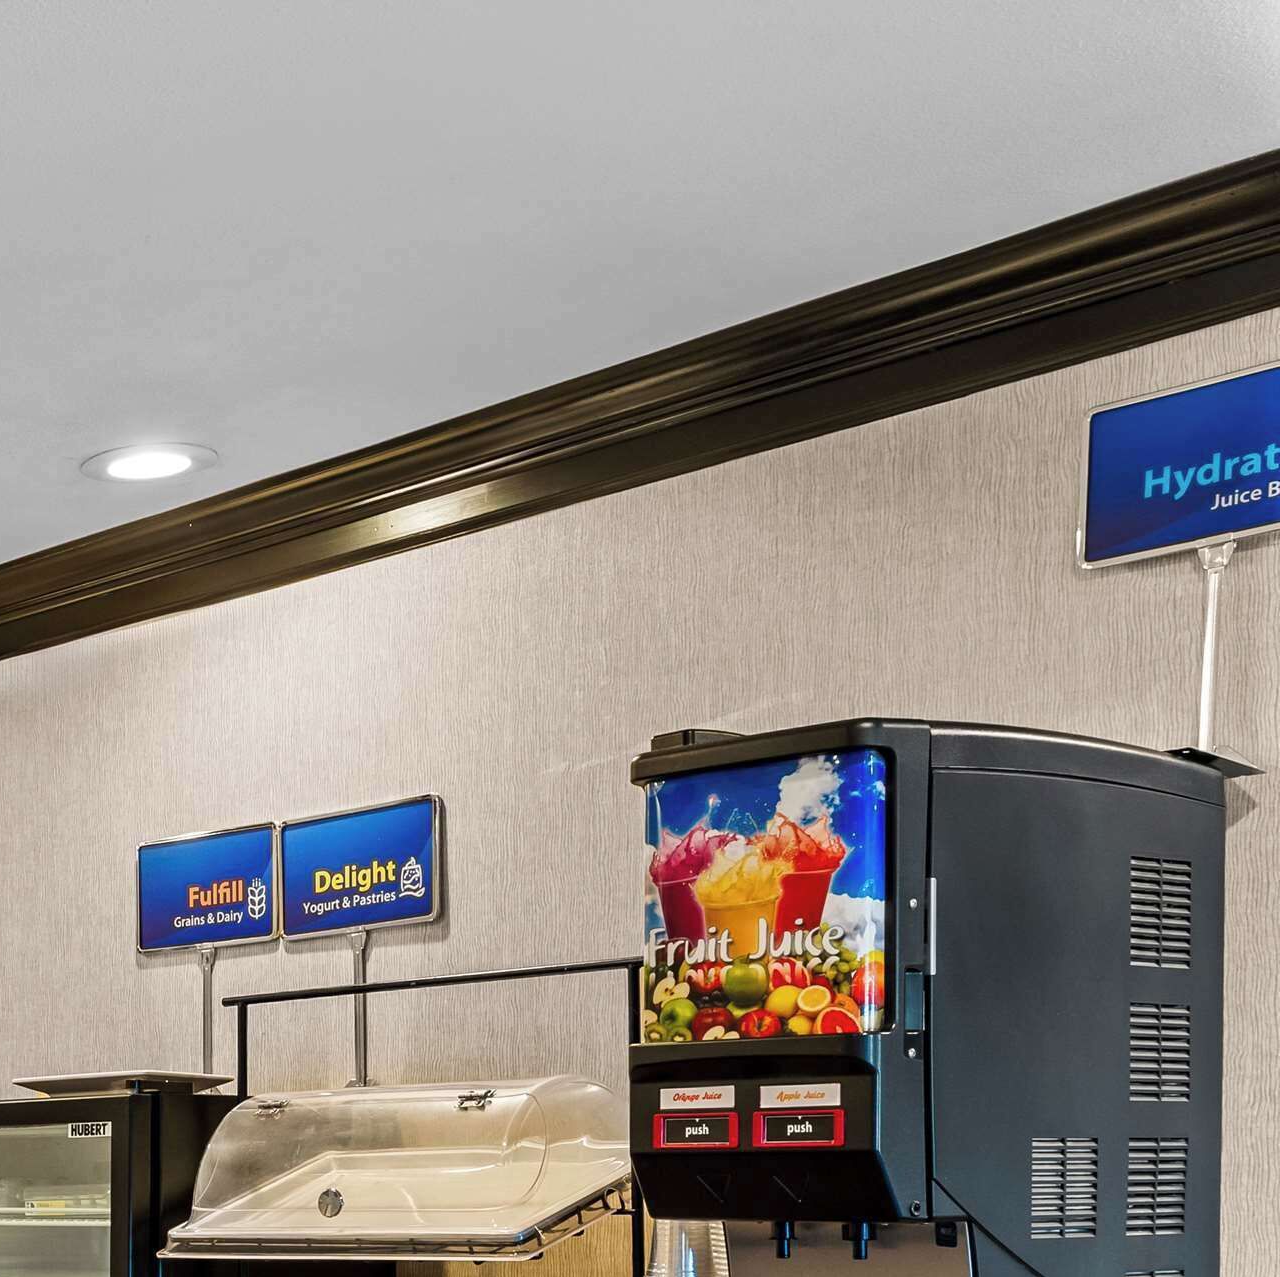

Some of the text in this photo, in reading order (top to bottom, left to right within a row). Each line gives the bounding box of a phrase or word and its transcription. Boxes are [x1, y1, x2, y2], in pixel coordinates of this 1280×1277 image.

[1210, 488, 1263, 511] Juice
[314, 860, 396, 895] Delight
[188, 879, 243, 908] Fulfill
[303, 890, 396, 915] Yogurt & Pastries
[174, 909, 243, 929] Grains & Dairy
[648, 917, 844, 967] Fruit Juice
[702, 1091, 722, 1100] Juice
[70, 1123, 108, 1137] HUBERT
[685, 1124, 709, 1138] push
[787, 1121, 813, 1136] push
